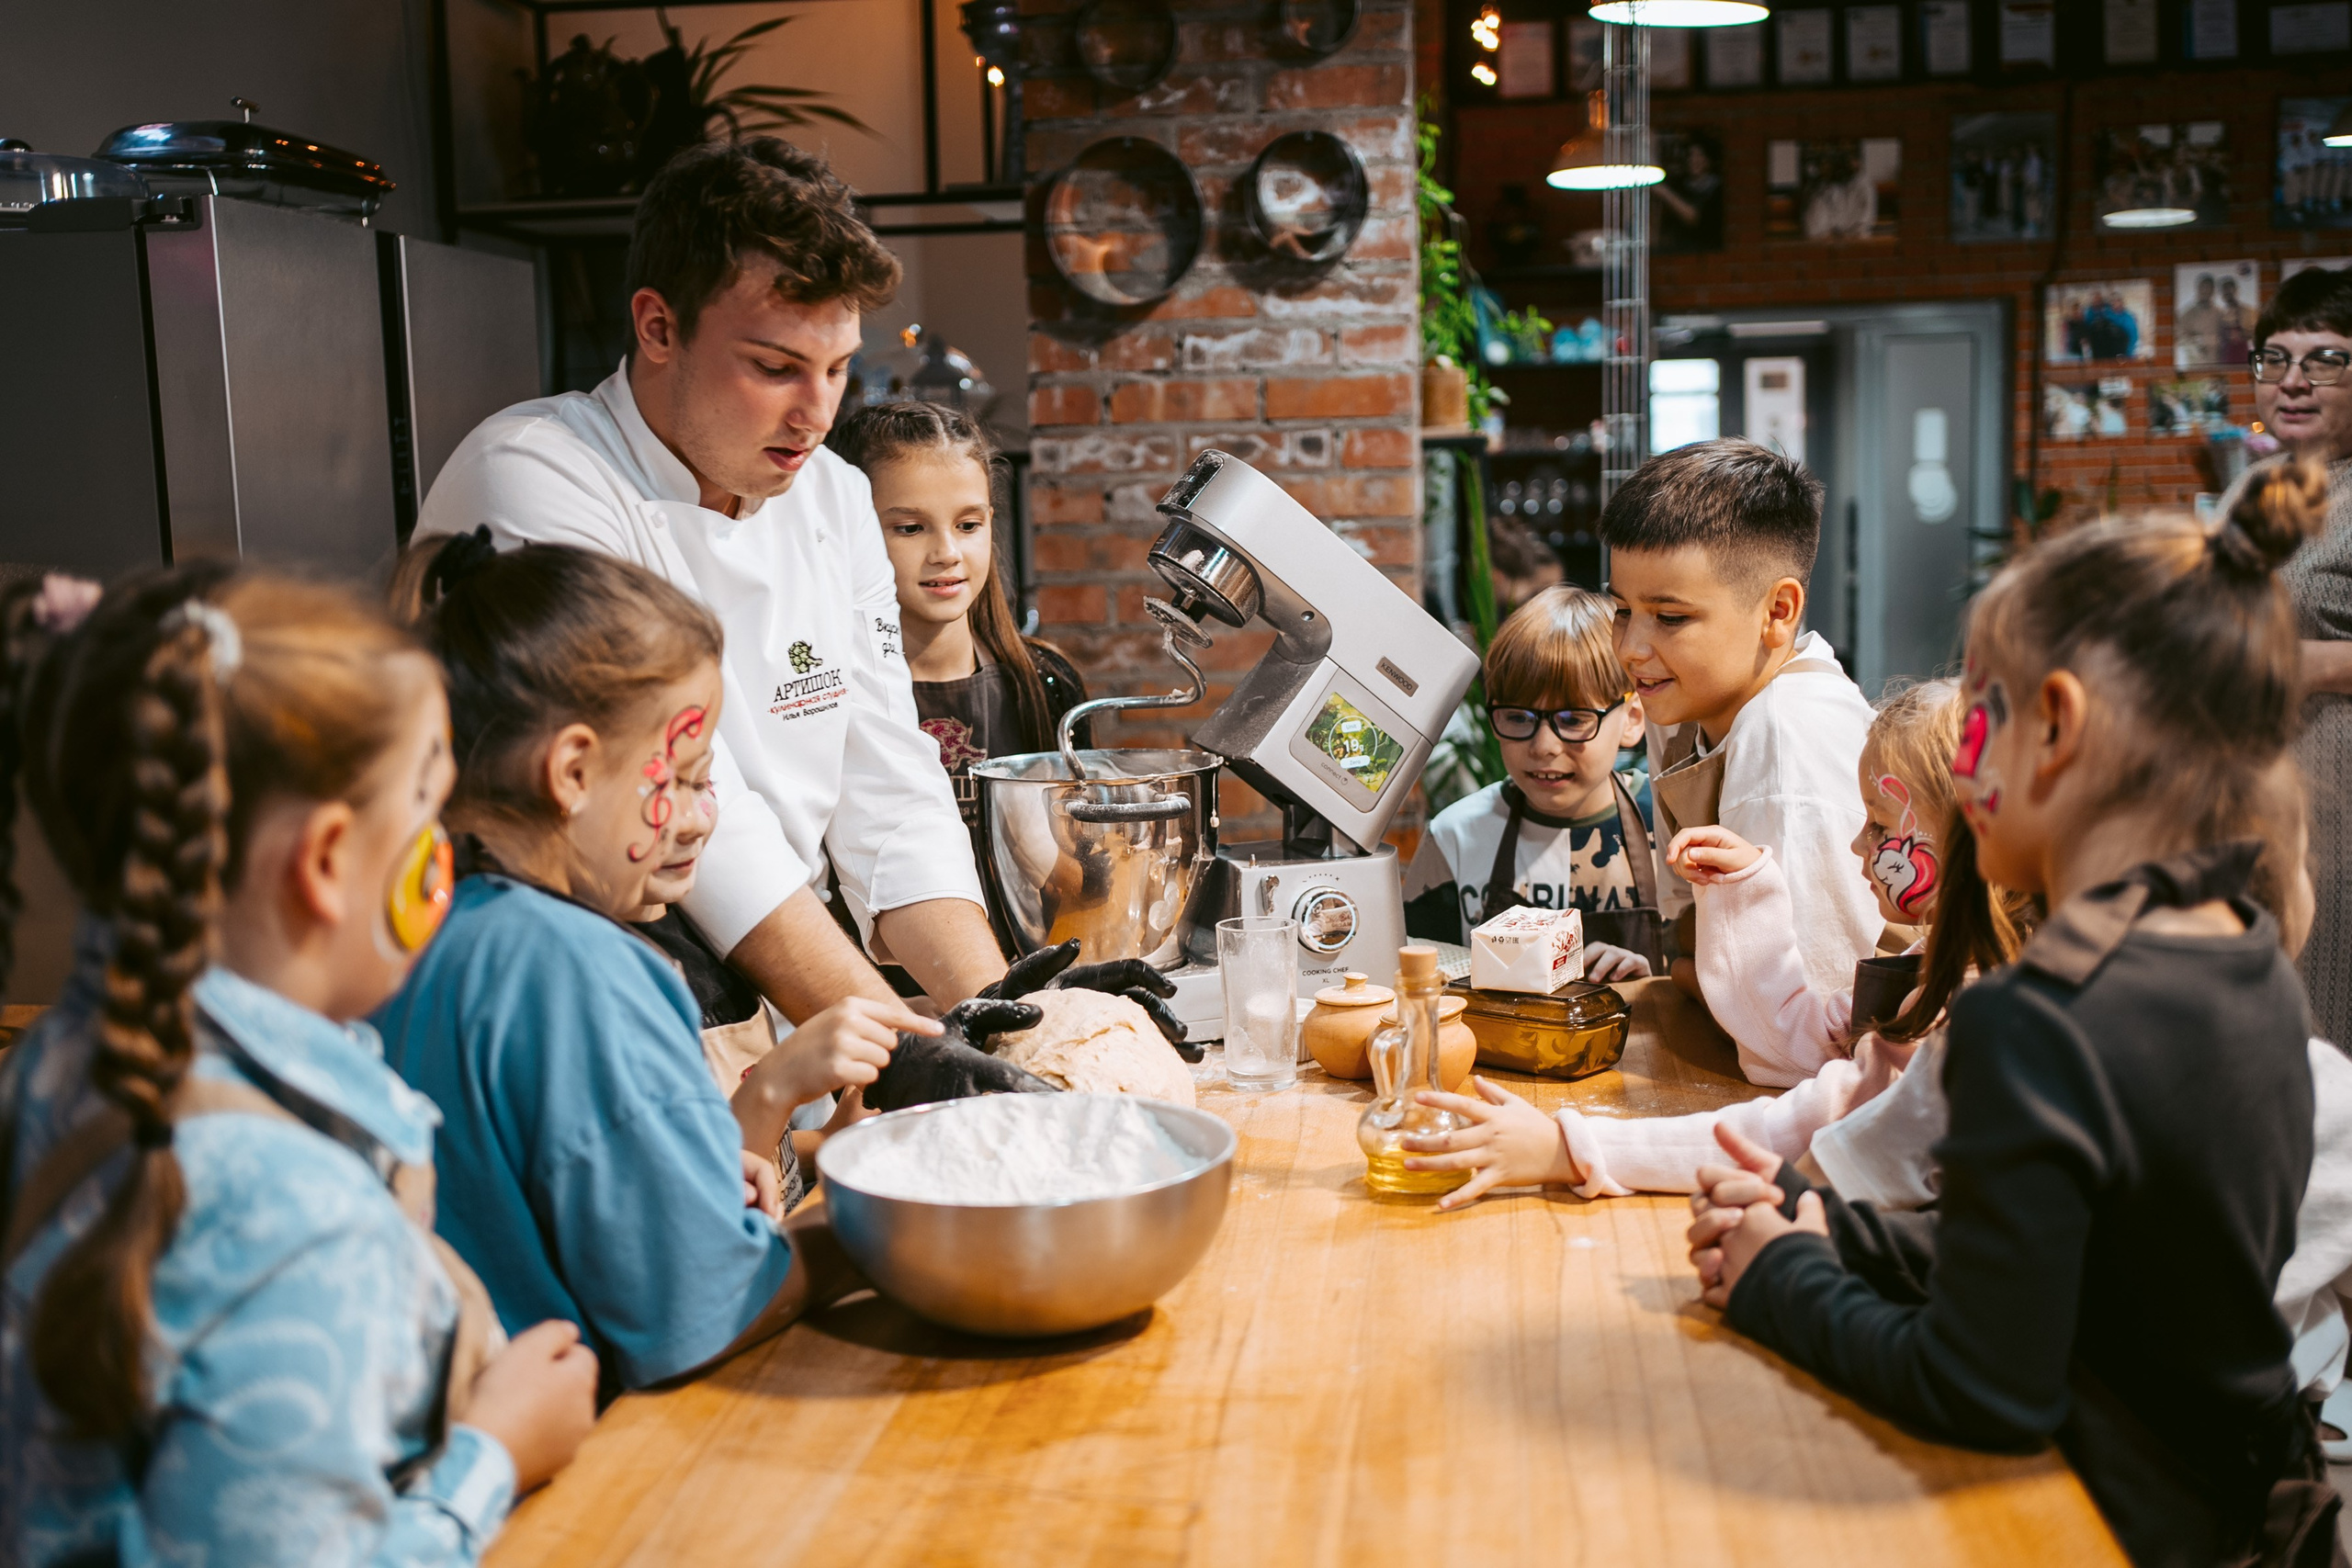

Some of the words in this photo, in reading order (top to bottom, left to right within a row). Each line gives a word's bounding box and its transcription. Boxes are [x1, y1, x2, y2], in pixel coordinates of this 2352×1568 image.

[774, 669, 842, 703] АРТИШОК
[1381, 662, 1413, 690] KENWOOD
[1320, 762, 1341, 780] connect
[1302, 968, 1331, 976] COOKING
